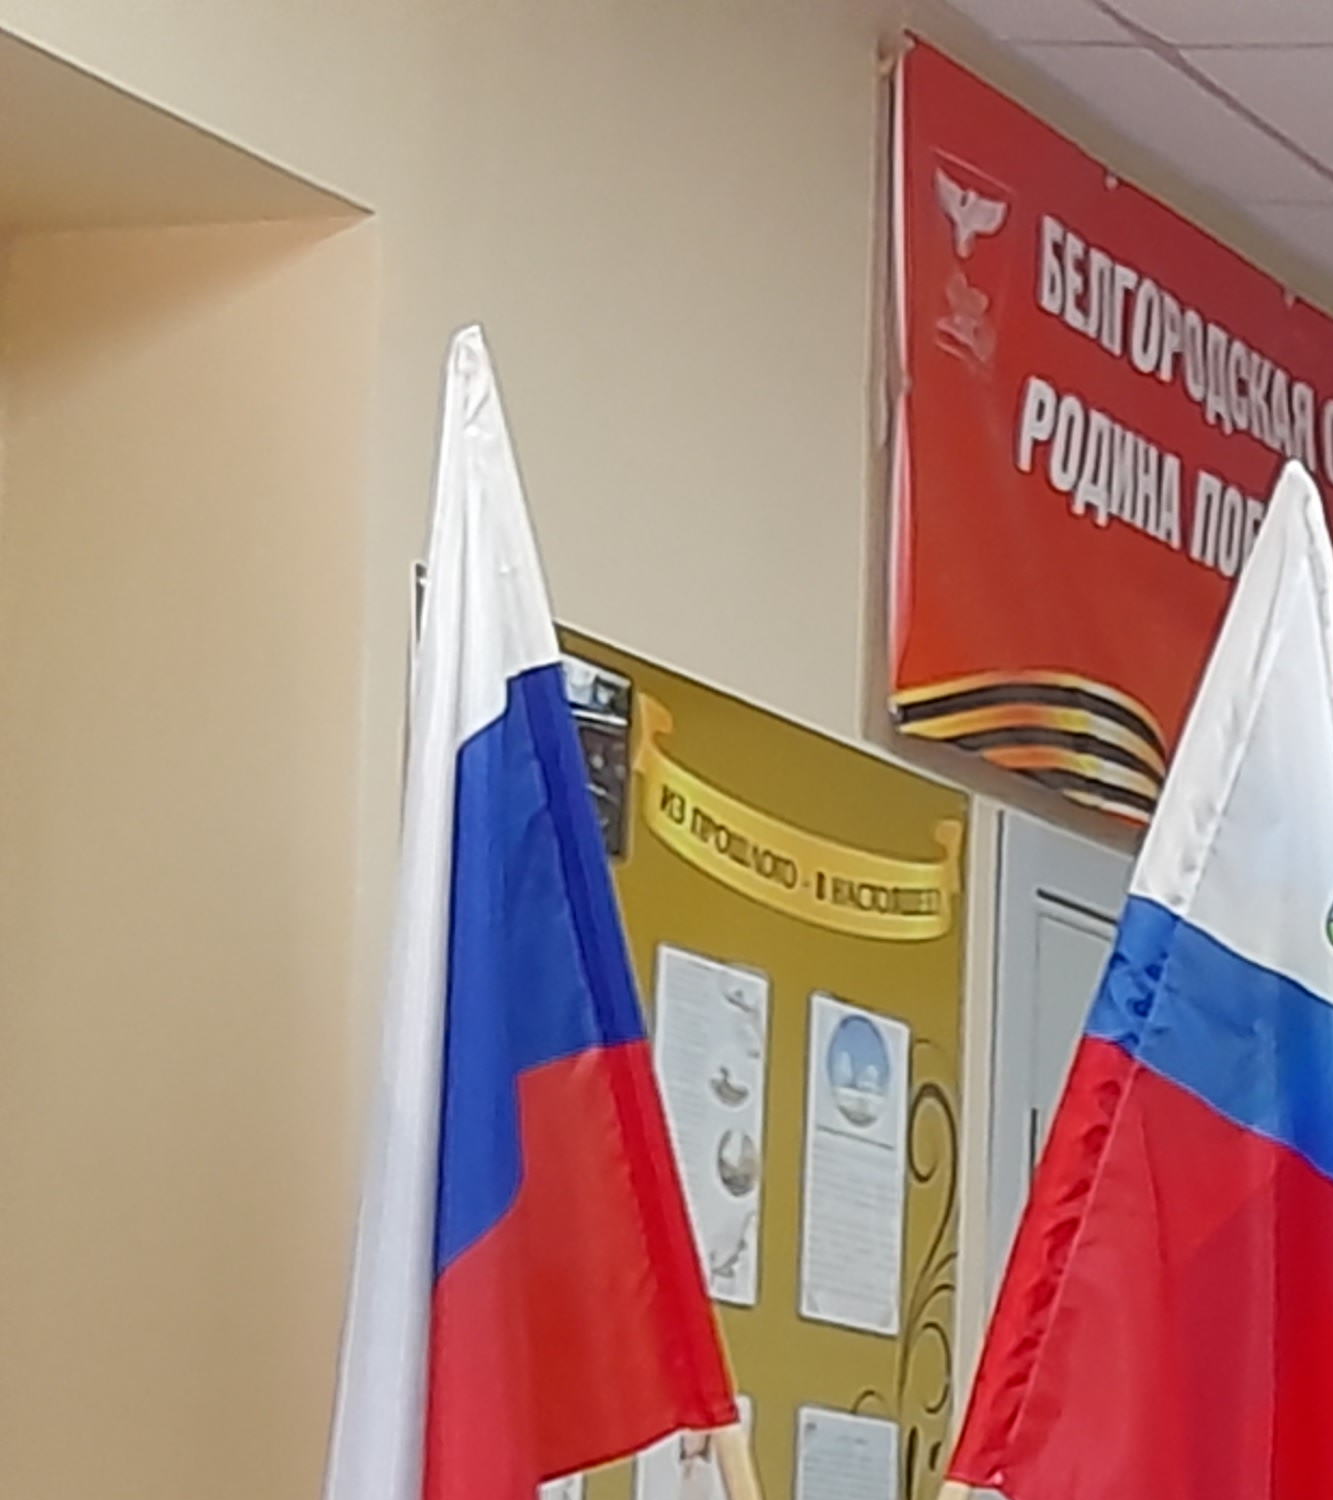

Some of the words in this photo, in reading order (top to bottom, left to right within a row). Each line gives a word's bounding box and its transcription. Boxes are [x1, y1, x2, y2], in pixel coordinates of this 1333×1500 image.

[1040, 214, 1317, 474] БЕЛГОРОДСКАЯ
[1016, 375, 1181, 551] РОДИНА
[660, 784, 686, 825] ИЗ
